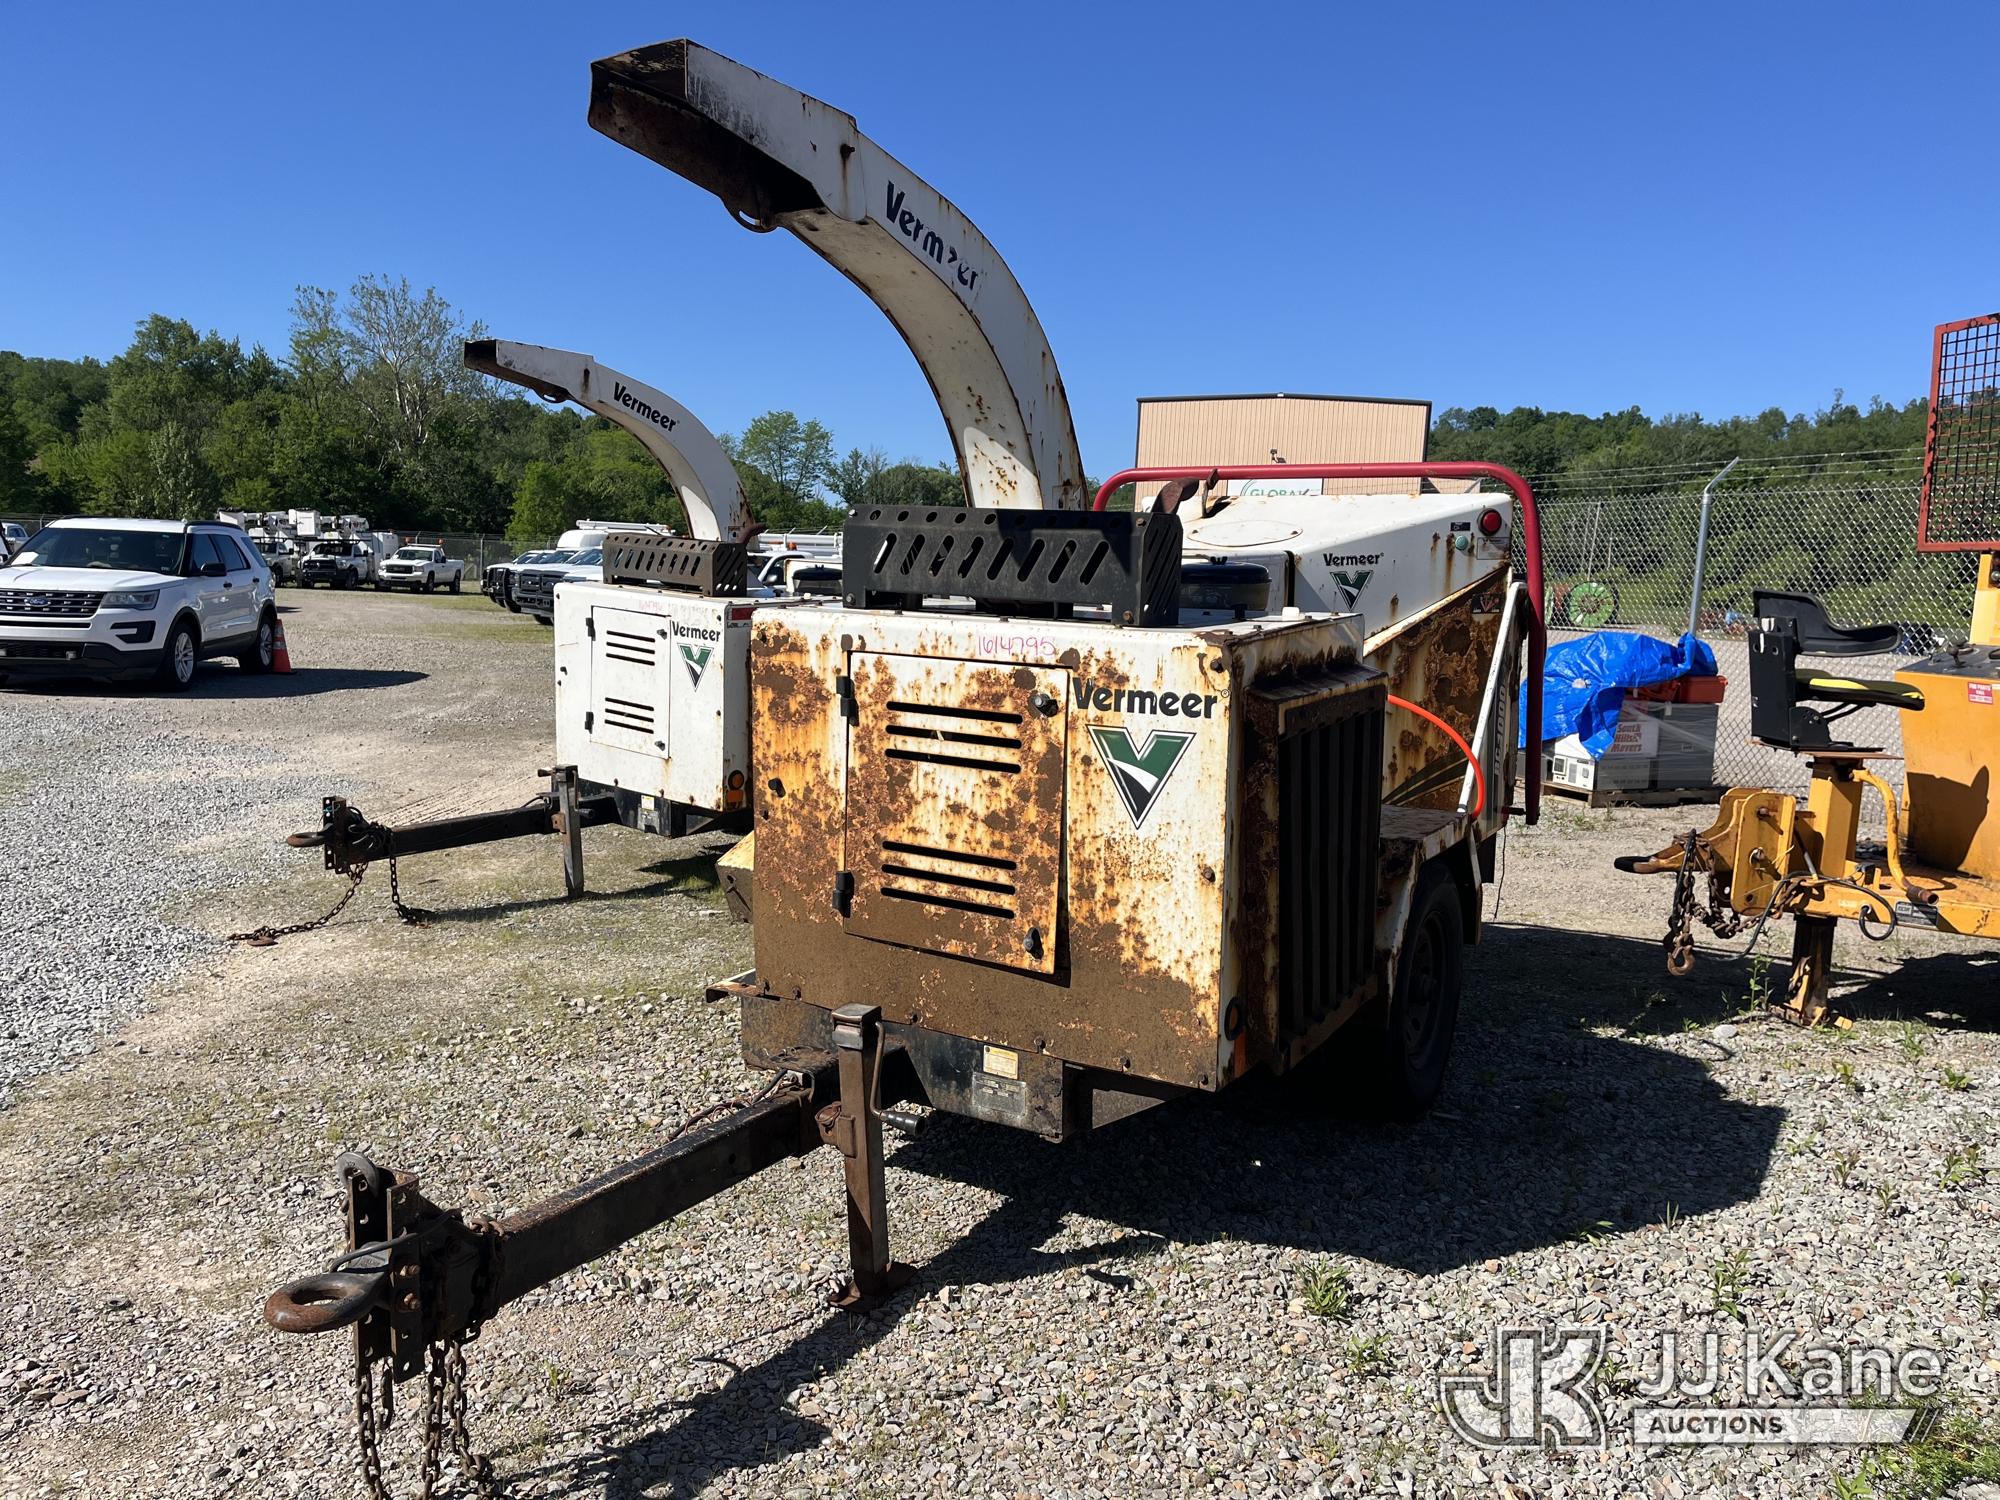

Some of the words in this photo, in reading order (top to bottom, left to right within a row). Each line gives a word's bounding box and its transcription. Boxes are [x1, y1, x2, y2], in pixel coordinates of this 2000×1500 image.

[613, 381, 677, 432] Vermeer
[1323, 552, 1381, 567] Vermeer
[671, 620, 721, 642] Vermeer
[978, 635, 1056, 656] 1614795
[1072, 677, 1217, 719] Vermeer
[1617, 723, 1641, 733] South
[1614, 733, 1633, 743] Hills
[1611, 744, 1642, 752] Movers
